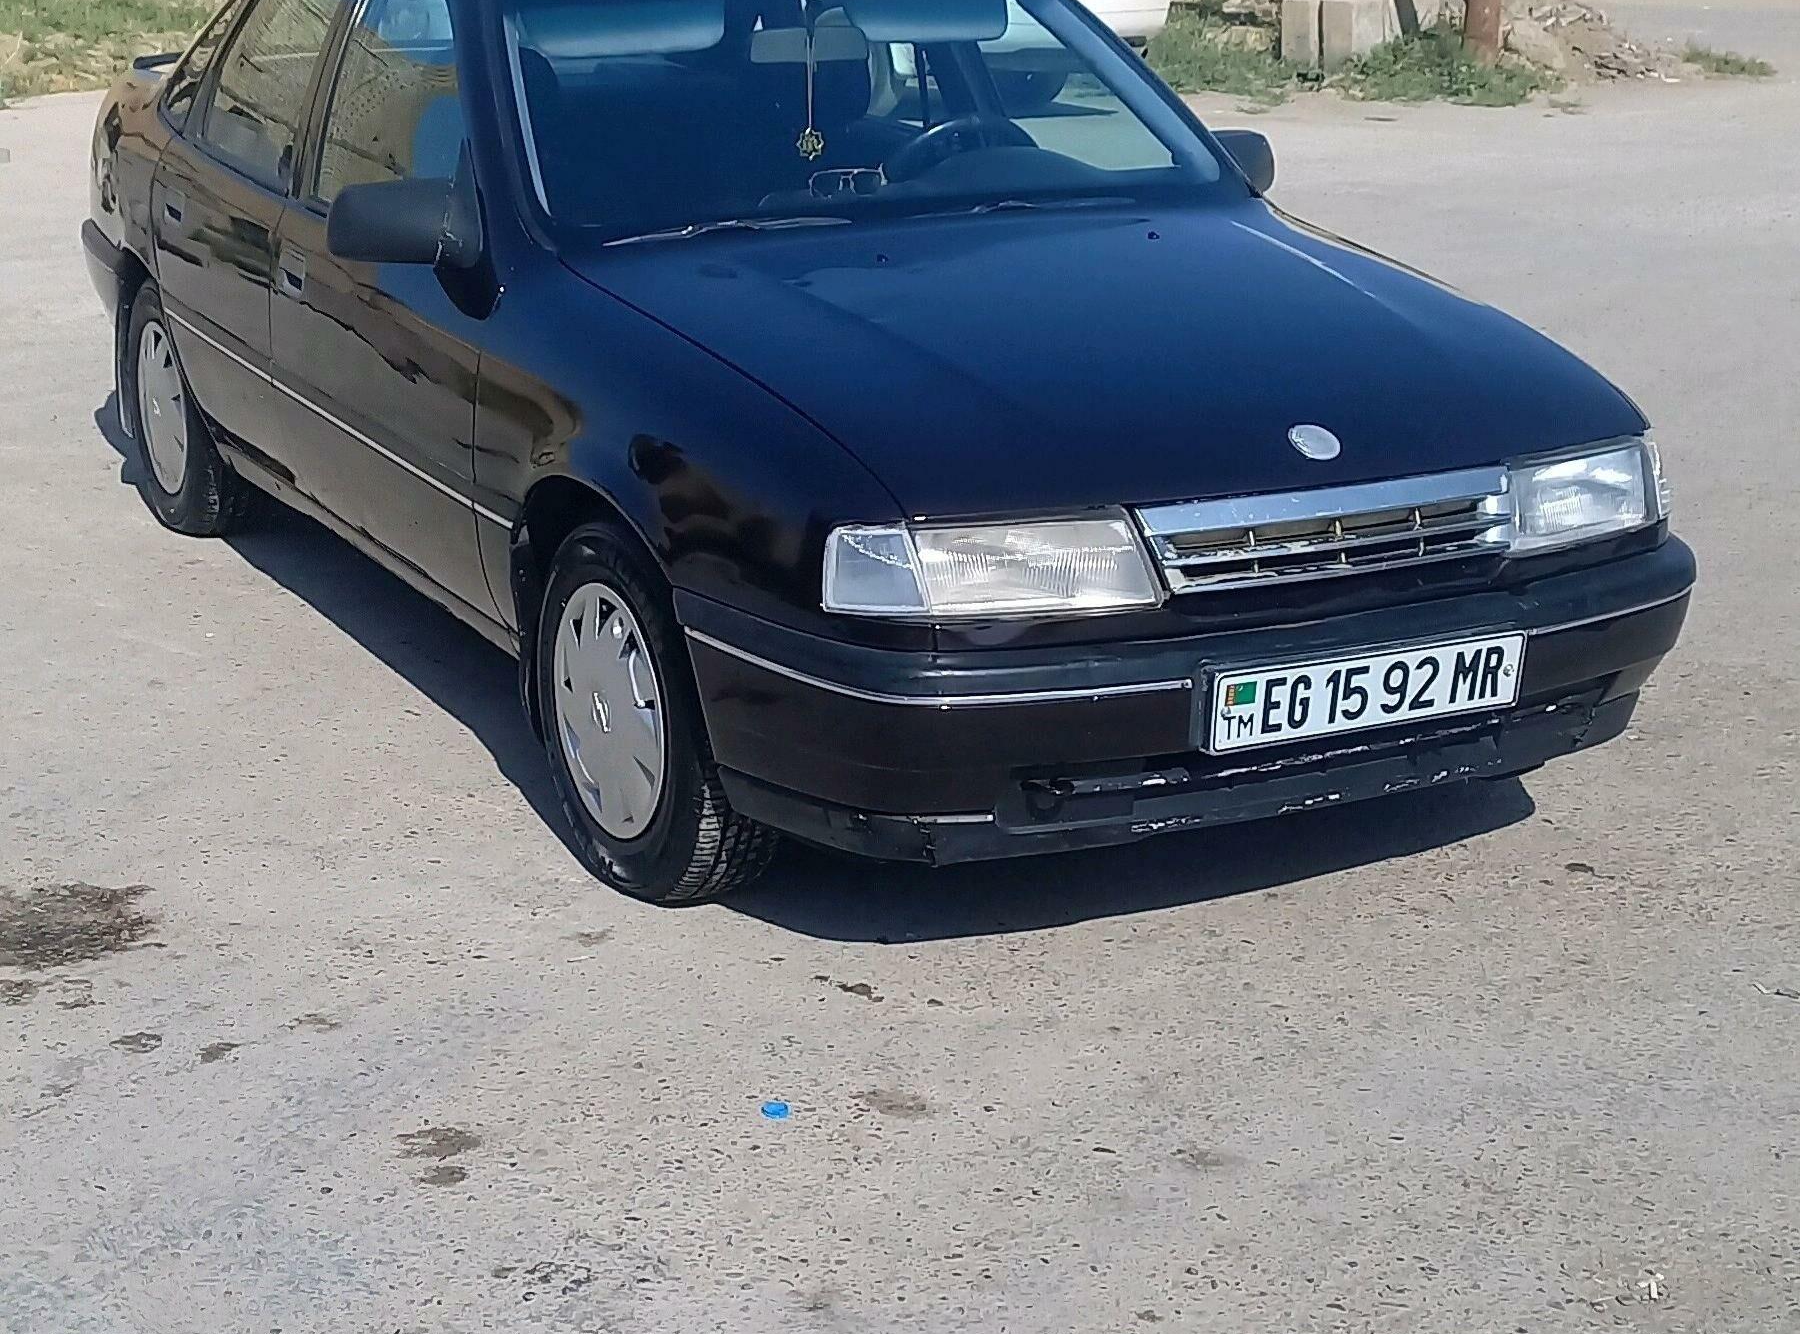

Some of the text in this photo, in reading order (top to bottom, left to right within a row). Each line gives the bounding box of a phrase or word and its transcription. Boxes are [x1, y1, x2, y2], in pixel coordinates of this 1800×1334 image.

[1260, 646, 1504, 735] EG 15 92 MR
[1223, 715, 1254, 740] TM
